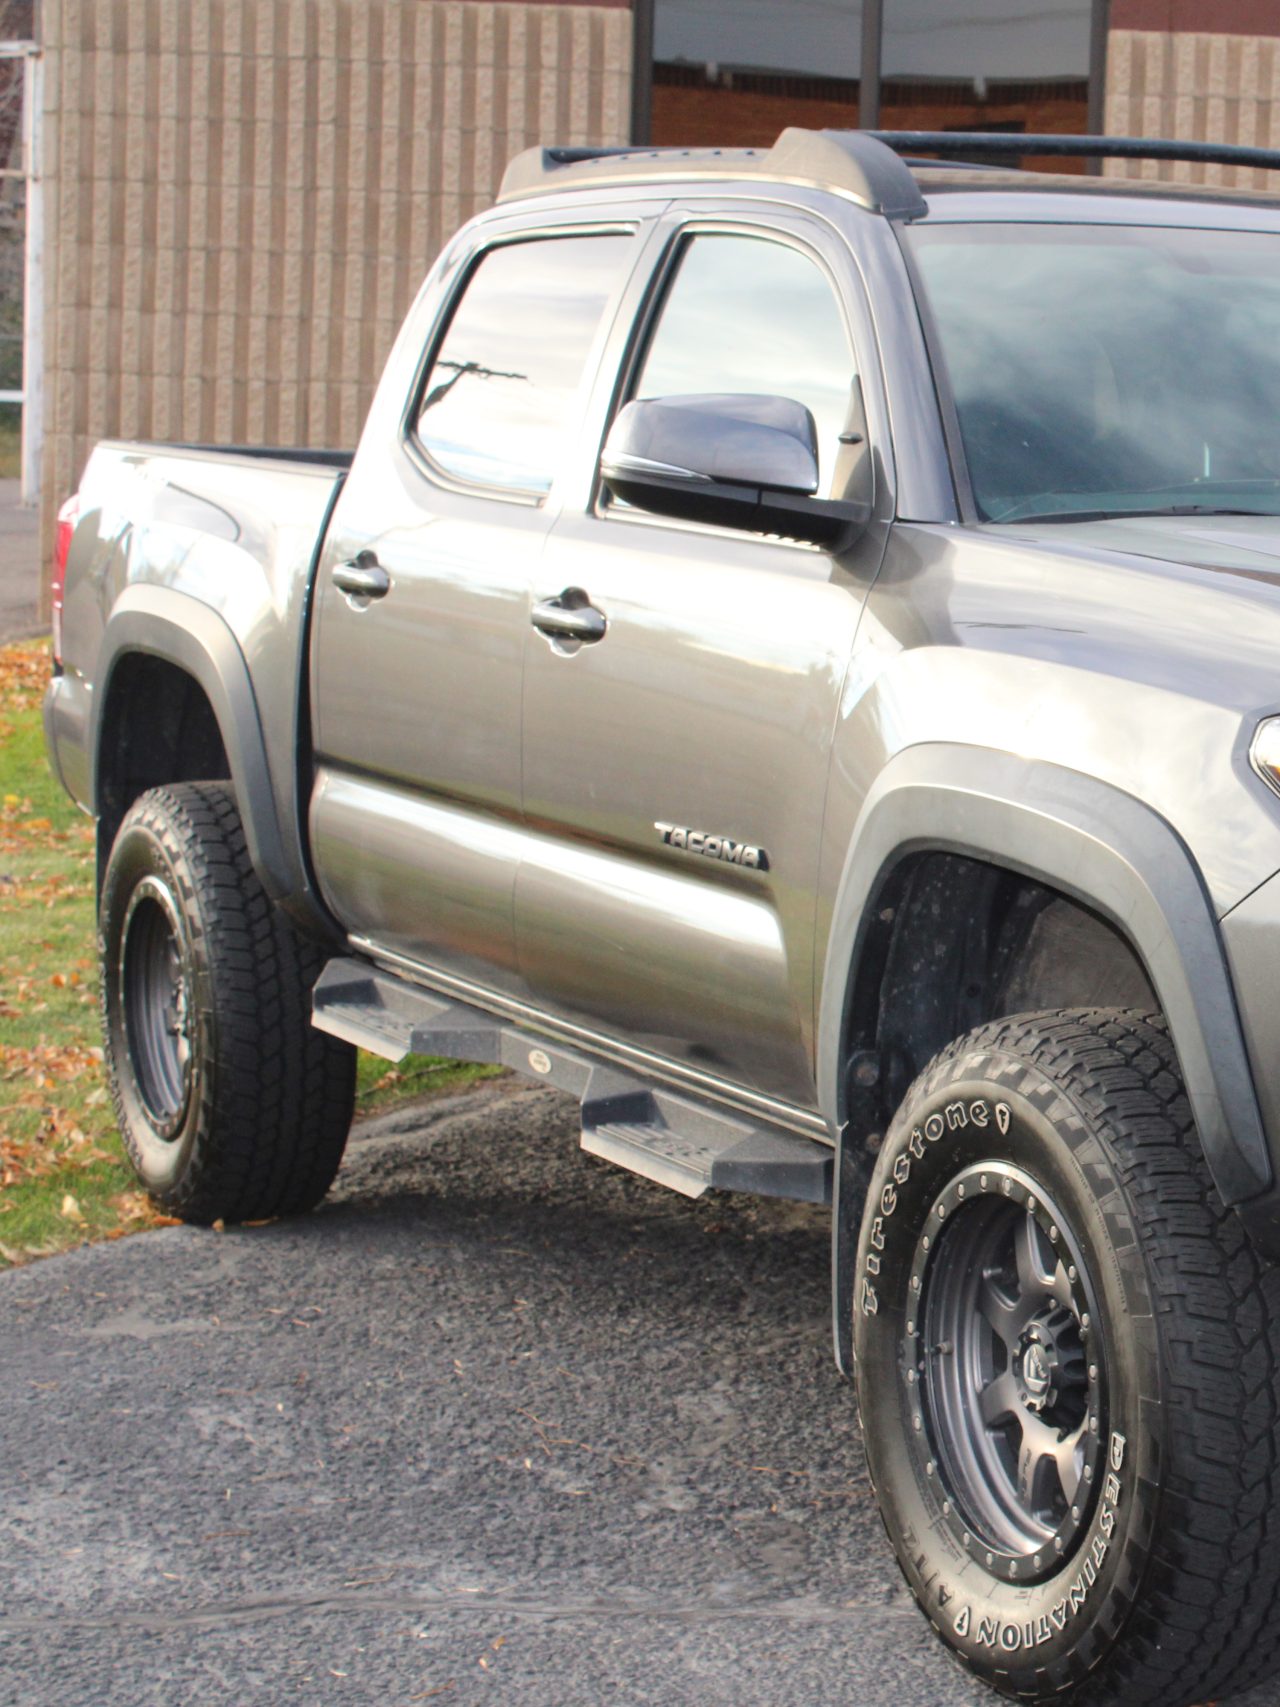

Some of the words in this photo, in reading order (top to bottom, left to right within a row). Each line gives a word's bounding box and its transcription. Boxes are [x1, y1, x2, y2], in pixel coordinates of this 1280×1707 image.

[654, 821, 765, 870] TACOMA
[861, 1100, 988, 1315] Firestone
[976, 1432, 1127, 1651] DESTINATION
